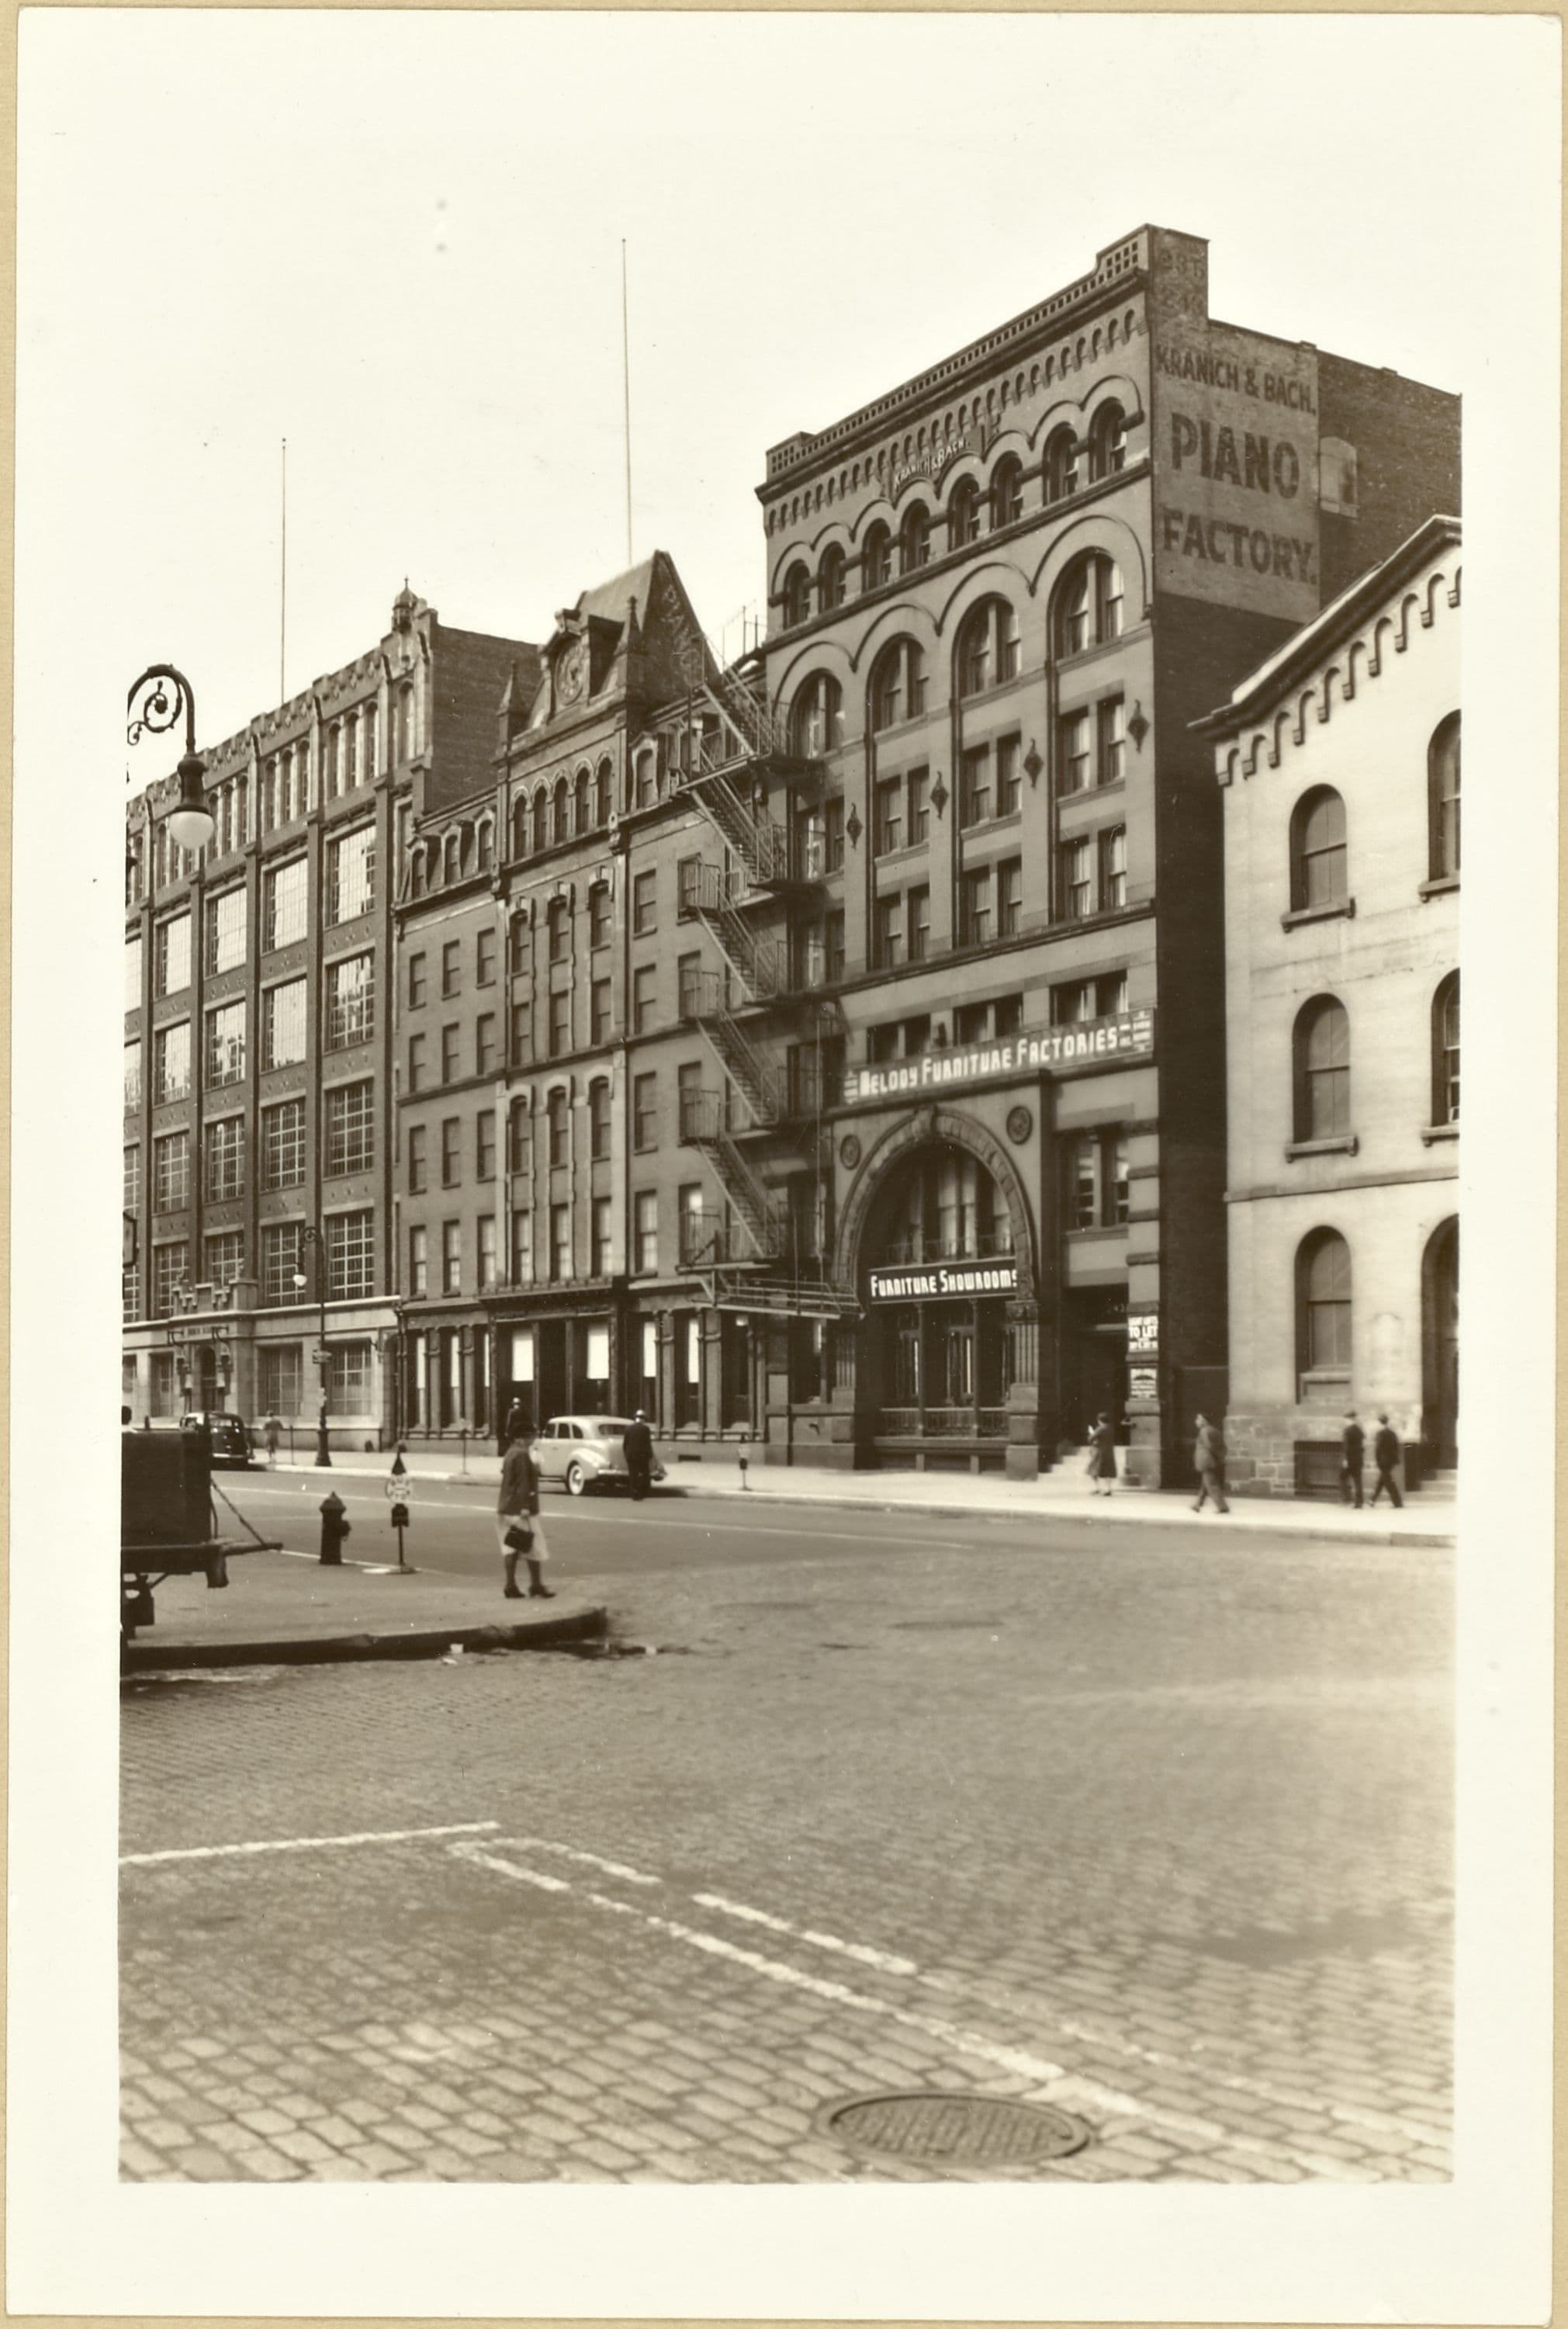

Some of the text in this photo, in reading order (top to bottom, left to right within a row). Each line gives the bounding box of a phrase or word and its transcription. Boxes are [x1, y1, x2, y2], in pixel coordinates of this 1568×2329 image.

[1155, 345, 1239, 393] KRANICH
[1245, 367, 1260, 399] &
[1172, 411, 1300, 499] PIANO
[860, 1066, 918, 1097] MELODY
[922, 1047, 1012, 1085] FURNITURE
[1016, 1026, 1117, 1068] FACTORIES
[871, 1276, 937, 1298] FURNITURE
